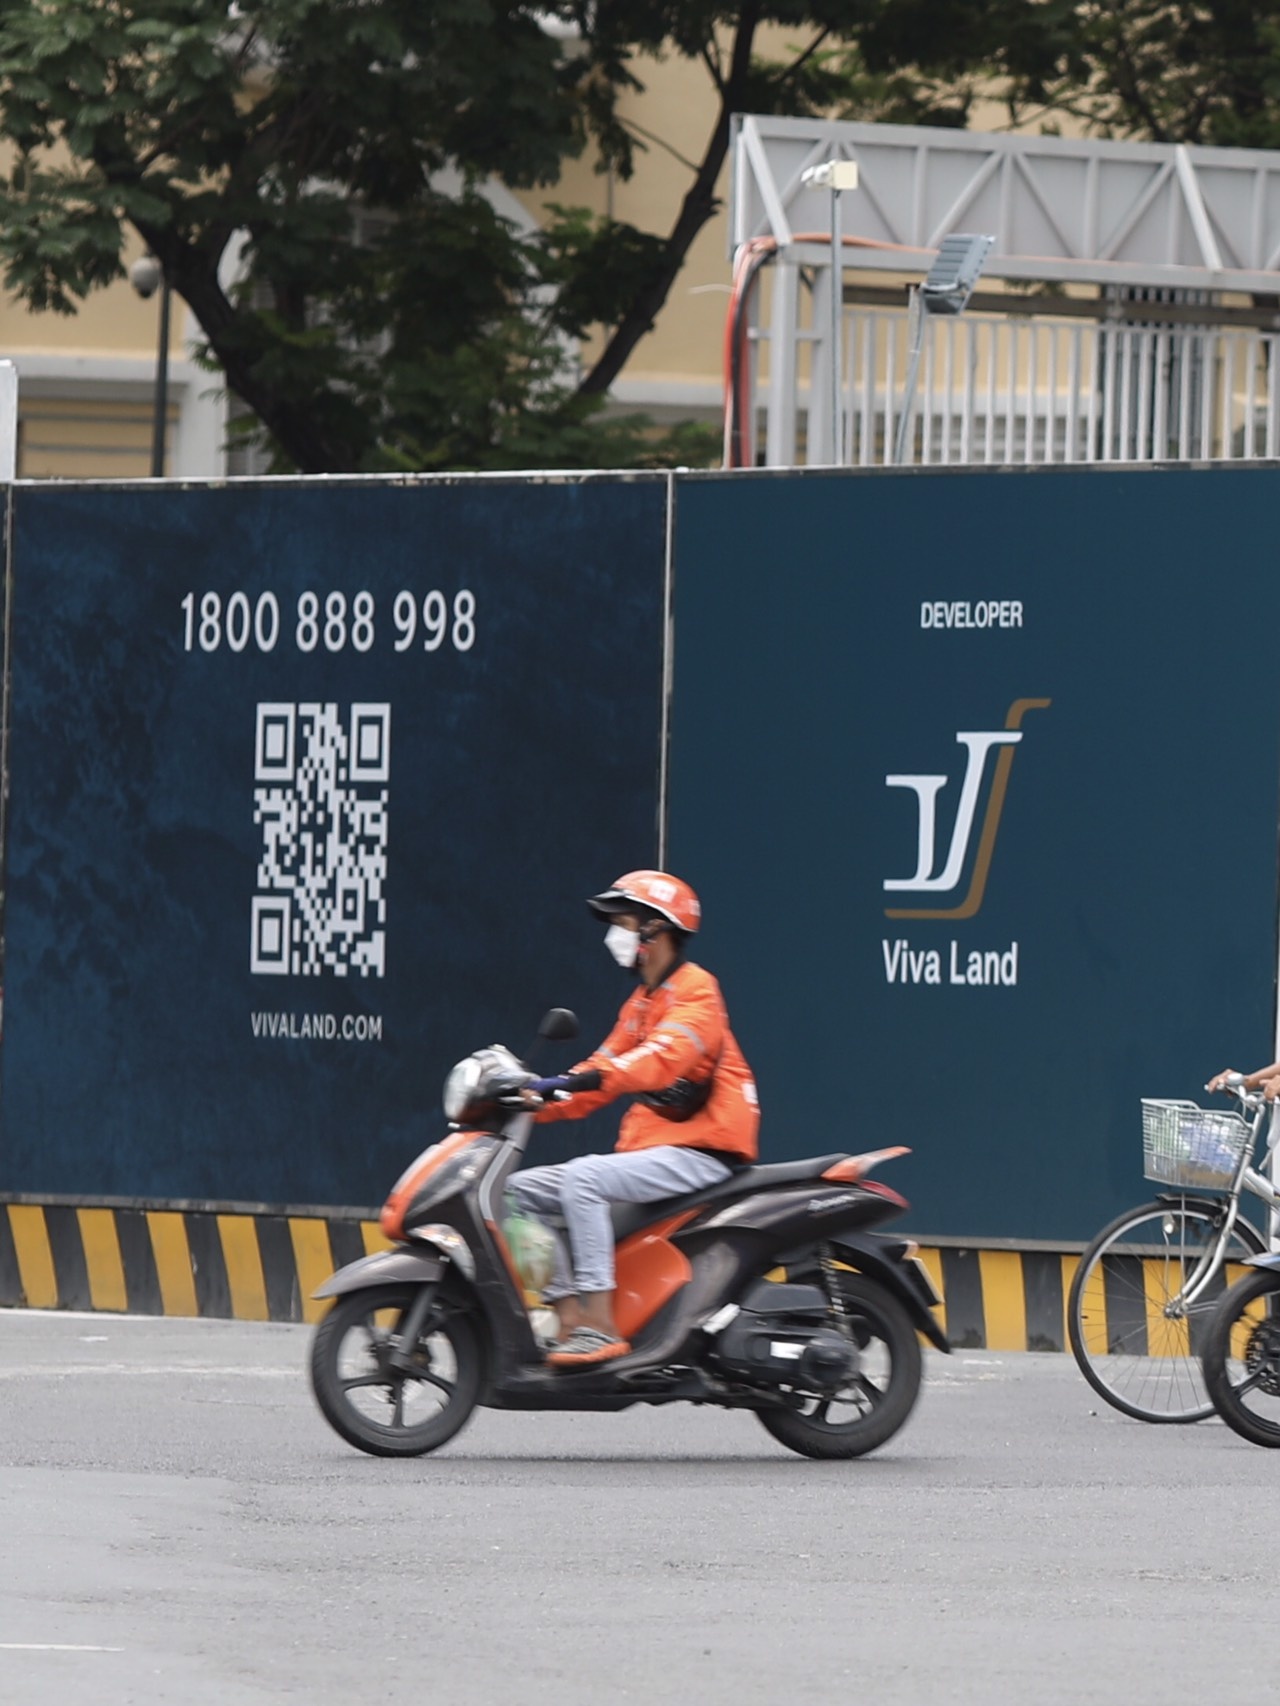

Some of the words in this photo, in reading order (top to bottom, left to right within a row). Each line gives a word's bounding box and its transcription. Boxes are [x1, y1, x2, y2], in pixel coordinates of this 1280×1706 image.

[180, 590, 280, 653] 1800
[295, 590, 376, 653] 888
[392, 589, 477, 653] 998
[919, 600, 1025, 629] DEVELOPER
[881, 939, 942, 986] Viva
[949, 939, 1019, 987] Land
[250, 1012, 384, 1041] VIVALAND.COM
